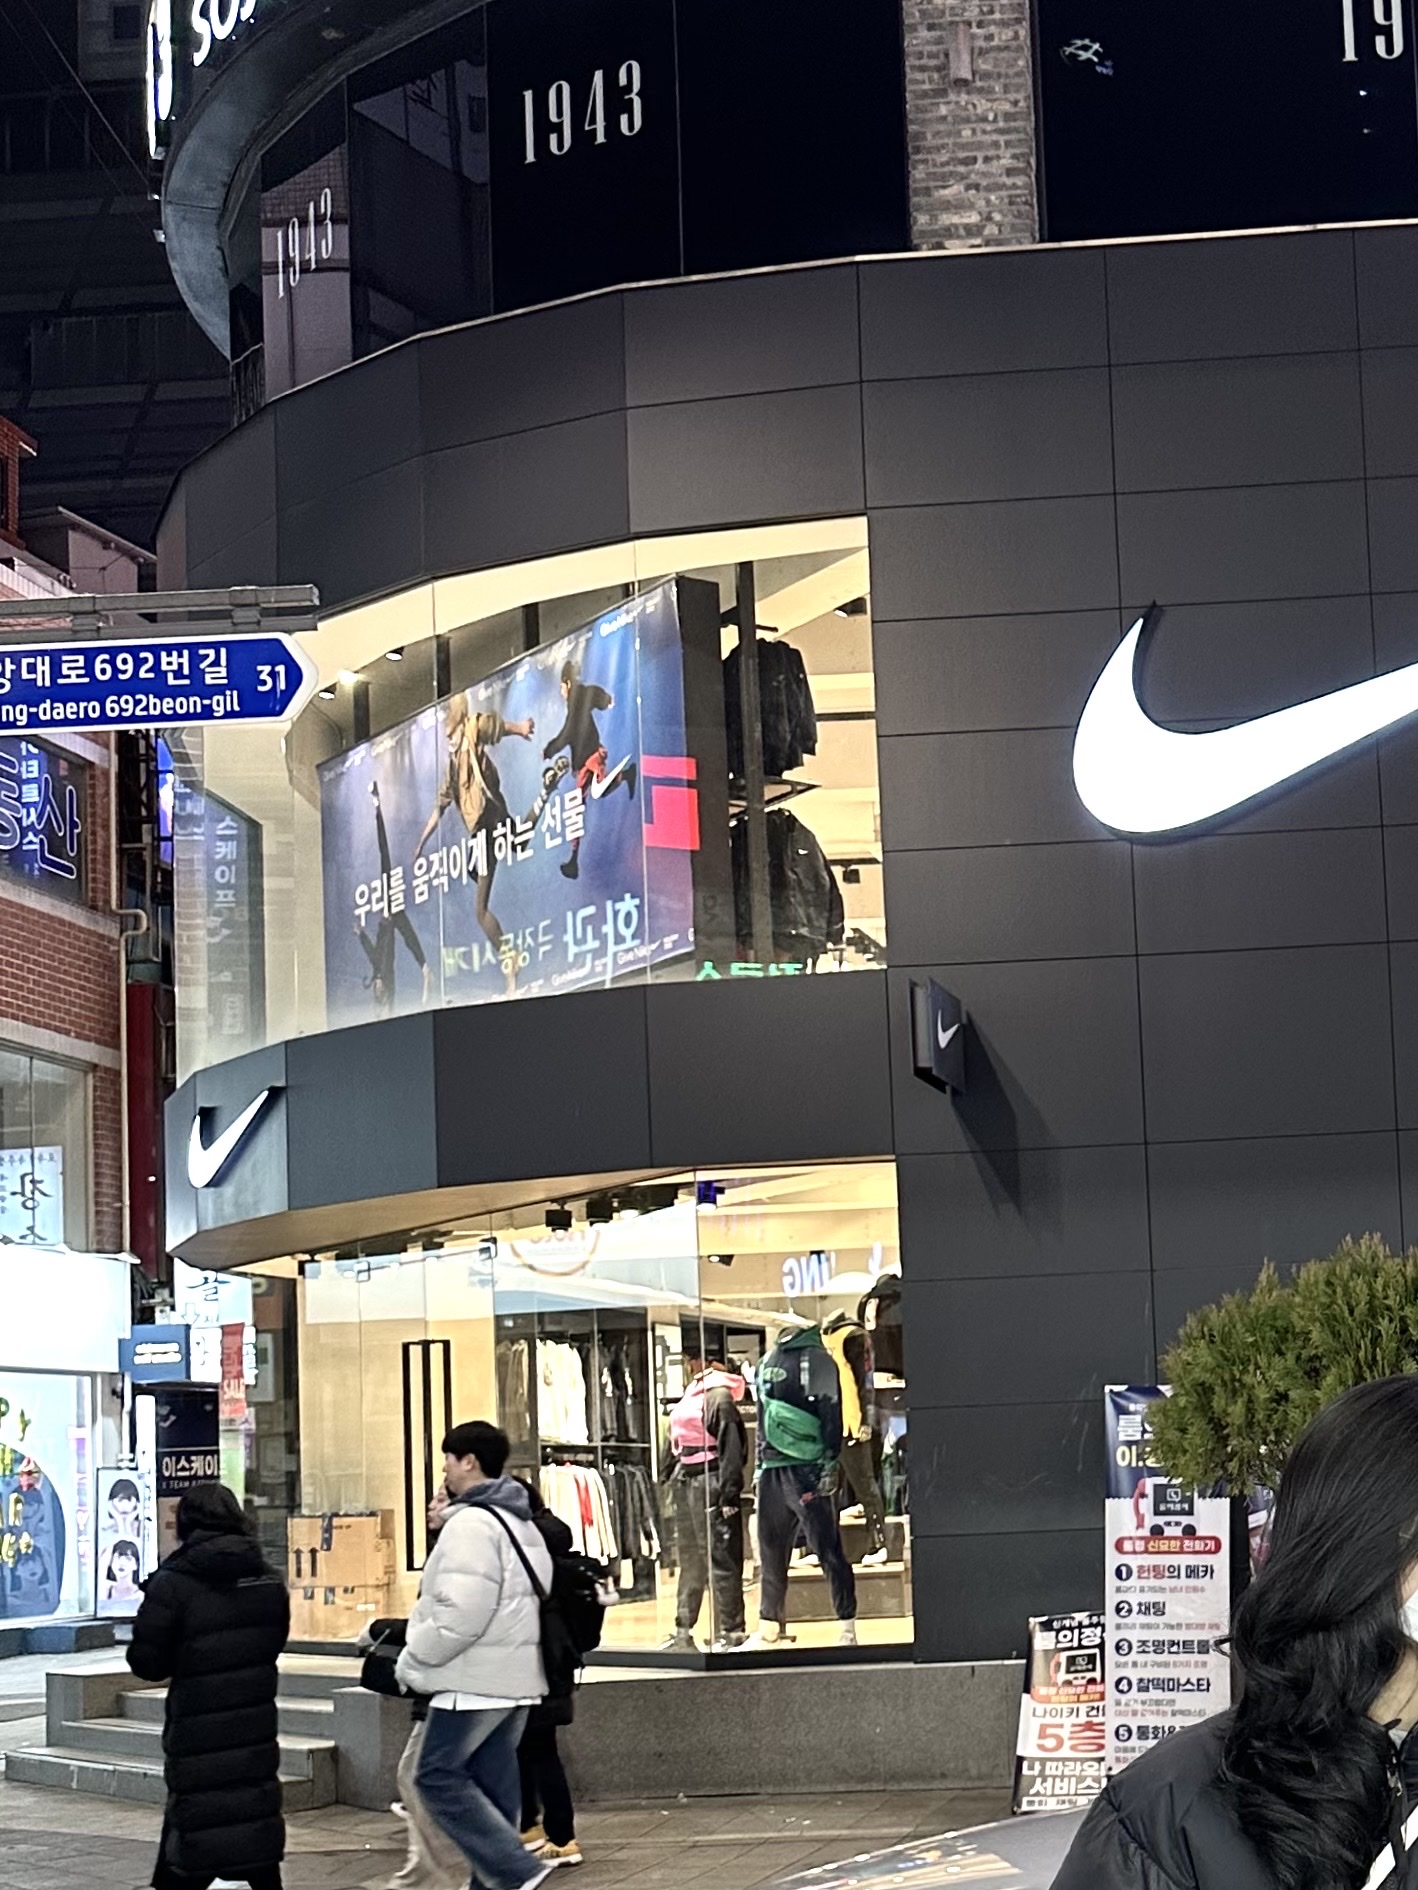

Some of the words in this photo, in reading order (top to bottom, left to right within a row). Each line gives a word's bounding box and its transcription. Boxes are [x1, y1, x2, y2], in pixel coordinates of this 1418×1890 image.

[522, 60, 642, 164] 1943
[277, 188, 332, 298] 1943
[256, 664, 286, 692] 31
[105, 690, 240, 718] 692beon-gil
[353, 866, 406, 927] 우리를
[412, 828, 488, 904] 움직이게
[493, 815, 536, 866] 하는
[541, 787, 586, 849] 선물
[1185, 1564, 1214, 1580] 메카
[1136, 1601, 1166, 1617] 채팅
[1032, 1706, 1079, 1719] 나이키
[1086, 1704, 1105, 1718] 건
[1036, 1720, 1105, 1753] 5층
[1022, 1760, 1041, 1776] 나
